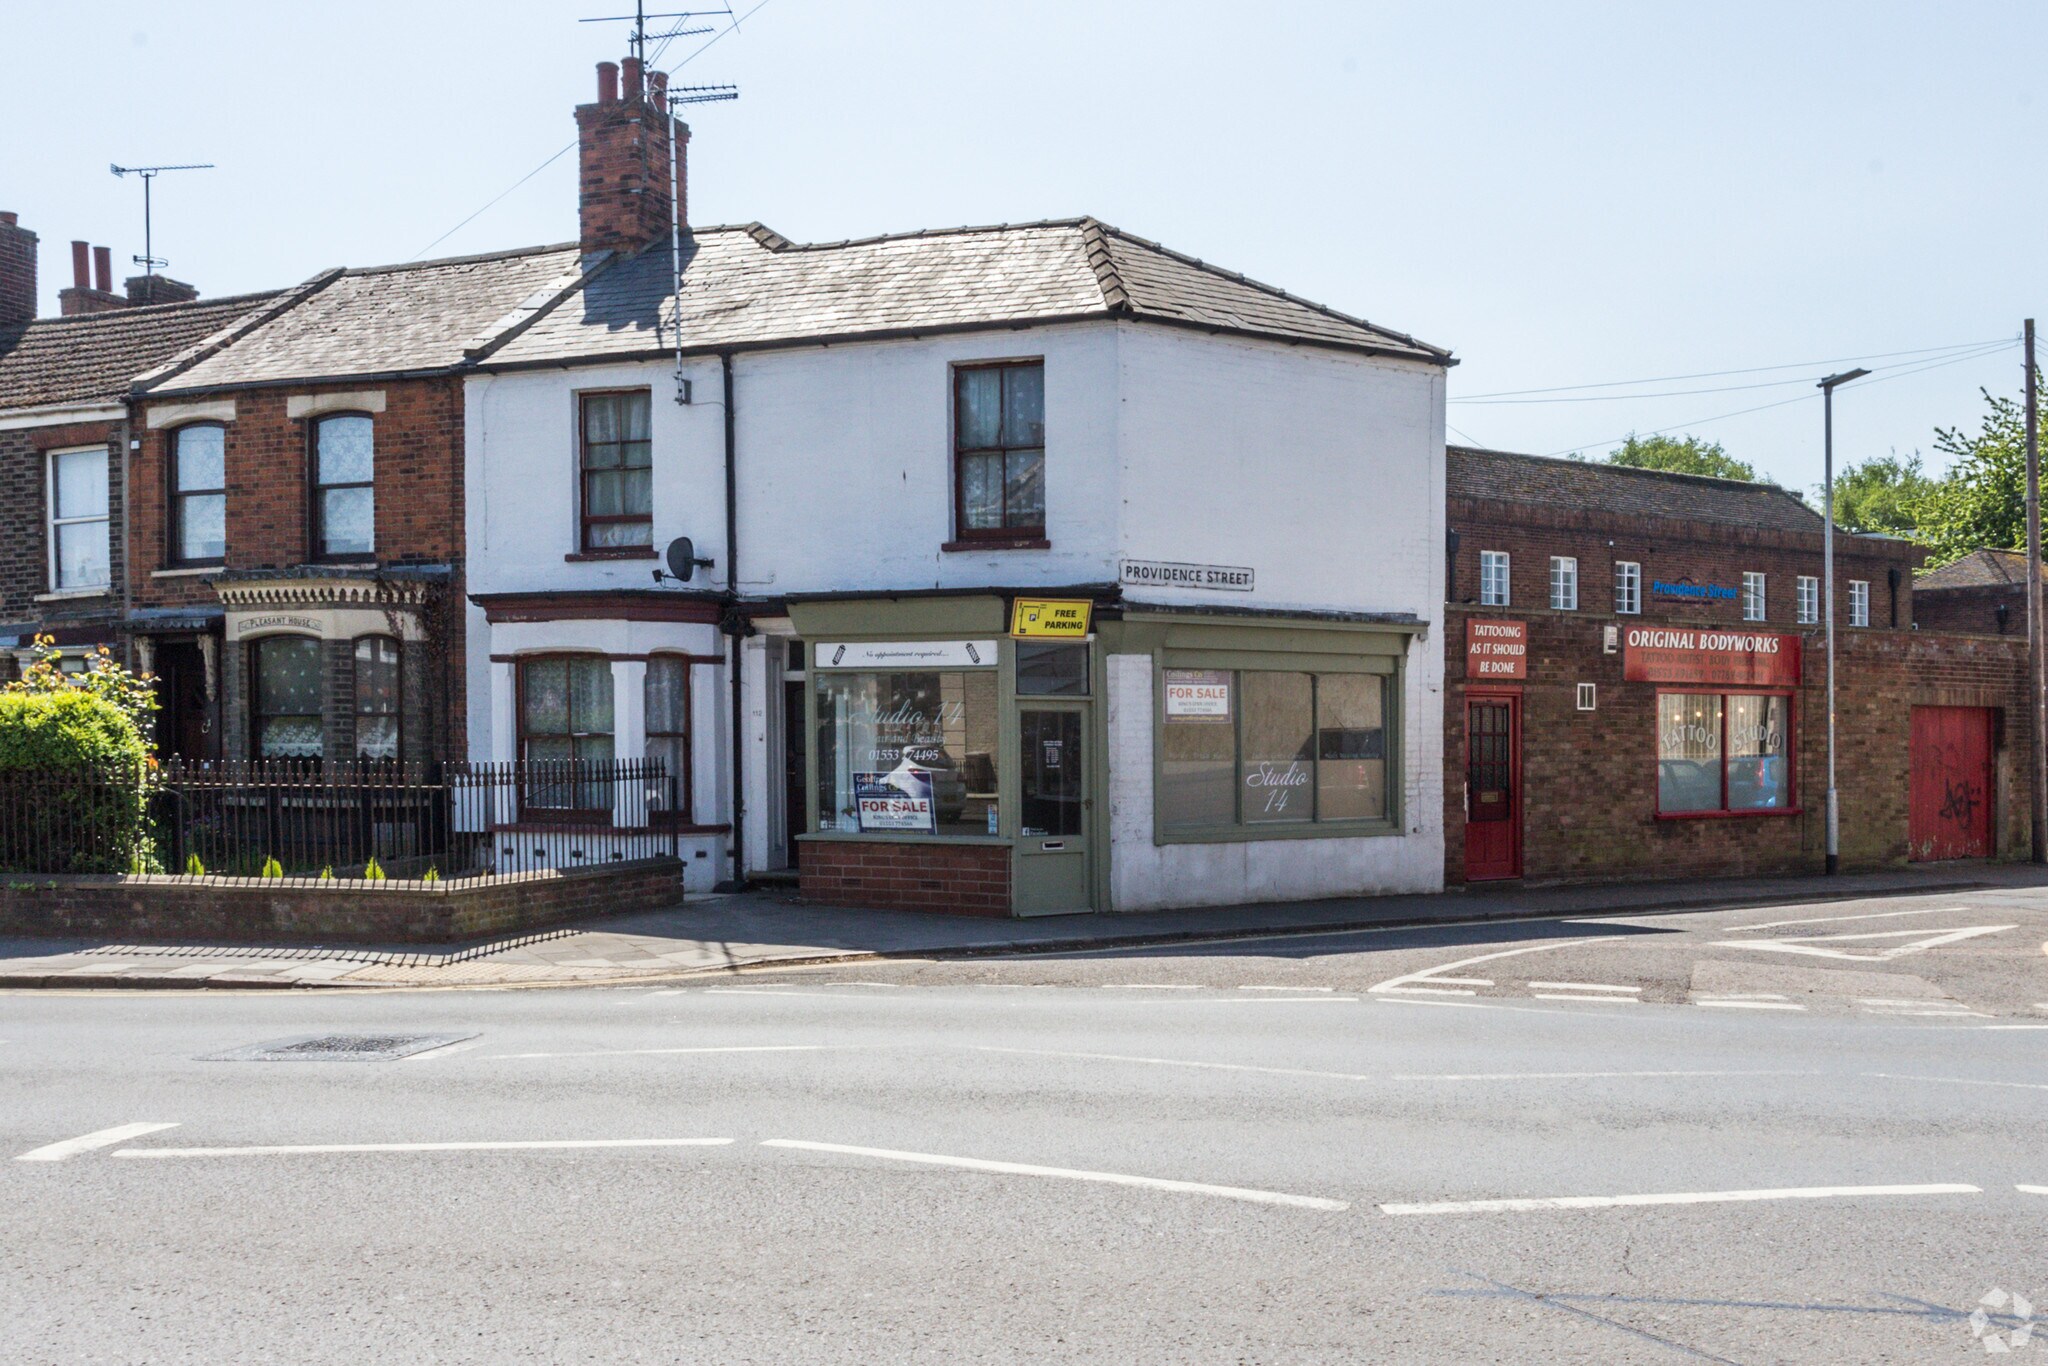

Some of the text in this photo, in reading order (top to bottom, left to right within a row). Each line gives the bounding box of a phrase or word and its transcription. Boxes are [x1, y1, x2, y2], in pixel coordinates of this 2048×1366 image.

[1126, 566, 1250, 585] PROVIDENCE STREET
[1653, 580, 1738, 599] Providence Street
[1054, 610, 1076, 618] FREE
[250, 616, 310, 628] PLEASANT HOUSE
[1044, 621, 1082, 630] PARKING
[1474, 624, 1520, 638] TATTOOING
[1628, 630, 1695, 650] ORIGINAL
[1700, 634, 1779, 653] BODYWORKS
[874, 650, 913, 660] appointment
[1470, 642, 1525, 656] AS IT SHOULD
[1641, 652, 1674, 664] TATTOO
[1480, 661, 1515, 673] BE DONE
[1169, 688, 1226, 698] FOR SALE
[932, 700, 965, 726] 14
[890, 732, 910, 744] and
[1662, 724, 1781, 750] TATTOO STUDIO
[868, 750, 900, 760] 01553
[1246, 761, 1308, 787] Studio
[1264, 788, 1288, 812] 14
[862, 801, 928, 812] FOR SALE
